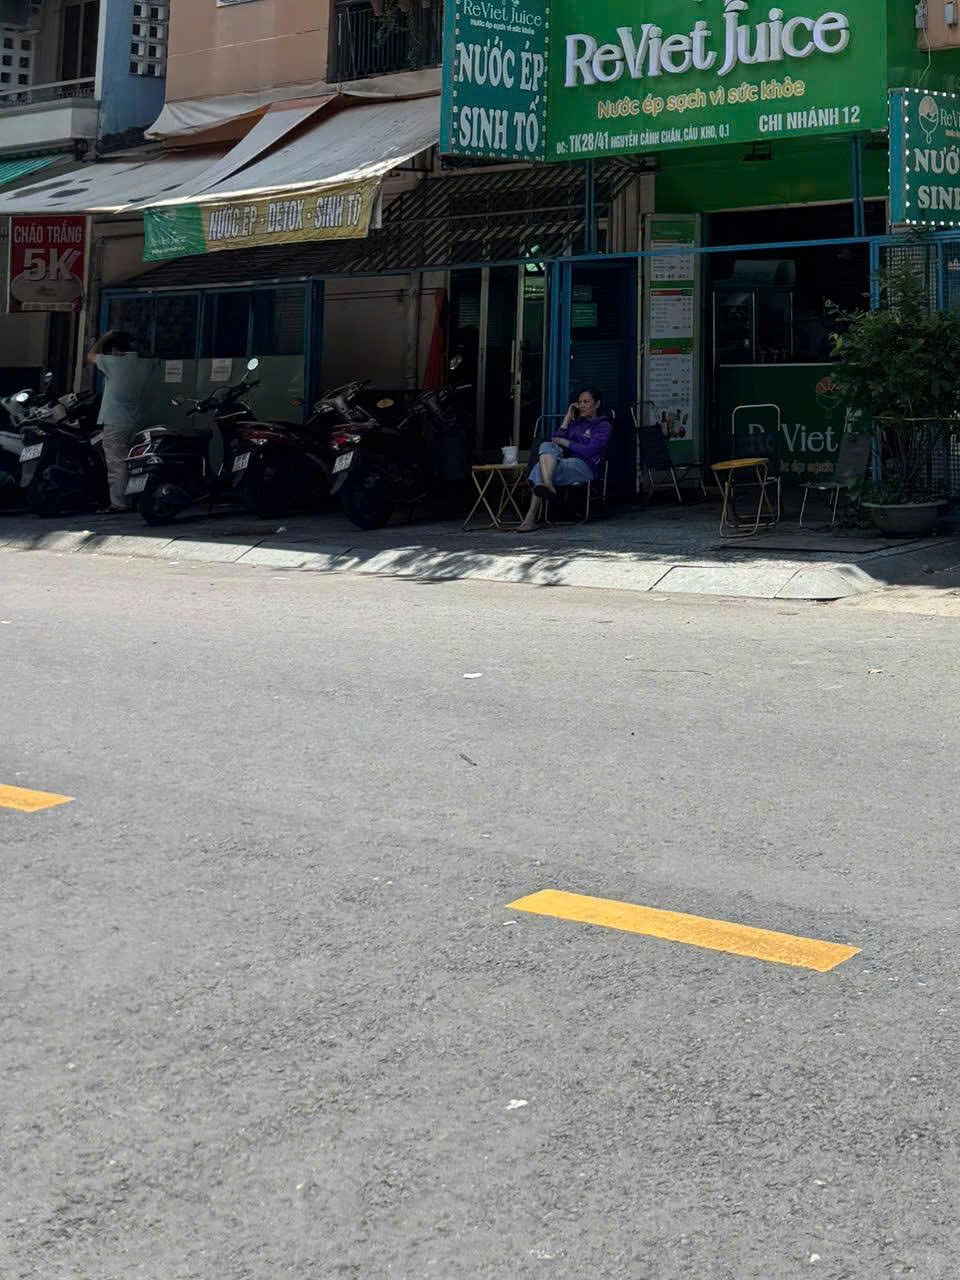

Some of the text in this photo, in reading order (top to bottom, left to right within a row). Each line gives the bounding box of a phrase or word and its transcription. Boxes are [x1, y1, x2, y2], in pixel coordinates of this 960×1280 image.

[510, 3, 542, 27] Juice
[564, 6, 850, 87] ReViet Juice
[456, 35, 545, 92] NƯỚC ÉP
[597, 76, 806, 119] Nước ép sạch vì sức khỏe
[459, 94, 540, 153] SINH TỐ
[758, 105, 860, 133] CHI NHÁNH 12
[569, 131, 609, 153] TK28/41
[266, 198, 305, 234] DETOX
[314, 194, 345, 230] SINH
[14, 220, 82, 244] CHÁO TRẮNG
[23, 248, 80, 281] 5K
[748, 423, 839, 453] RViet
